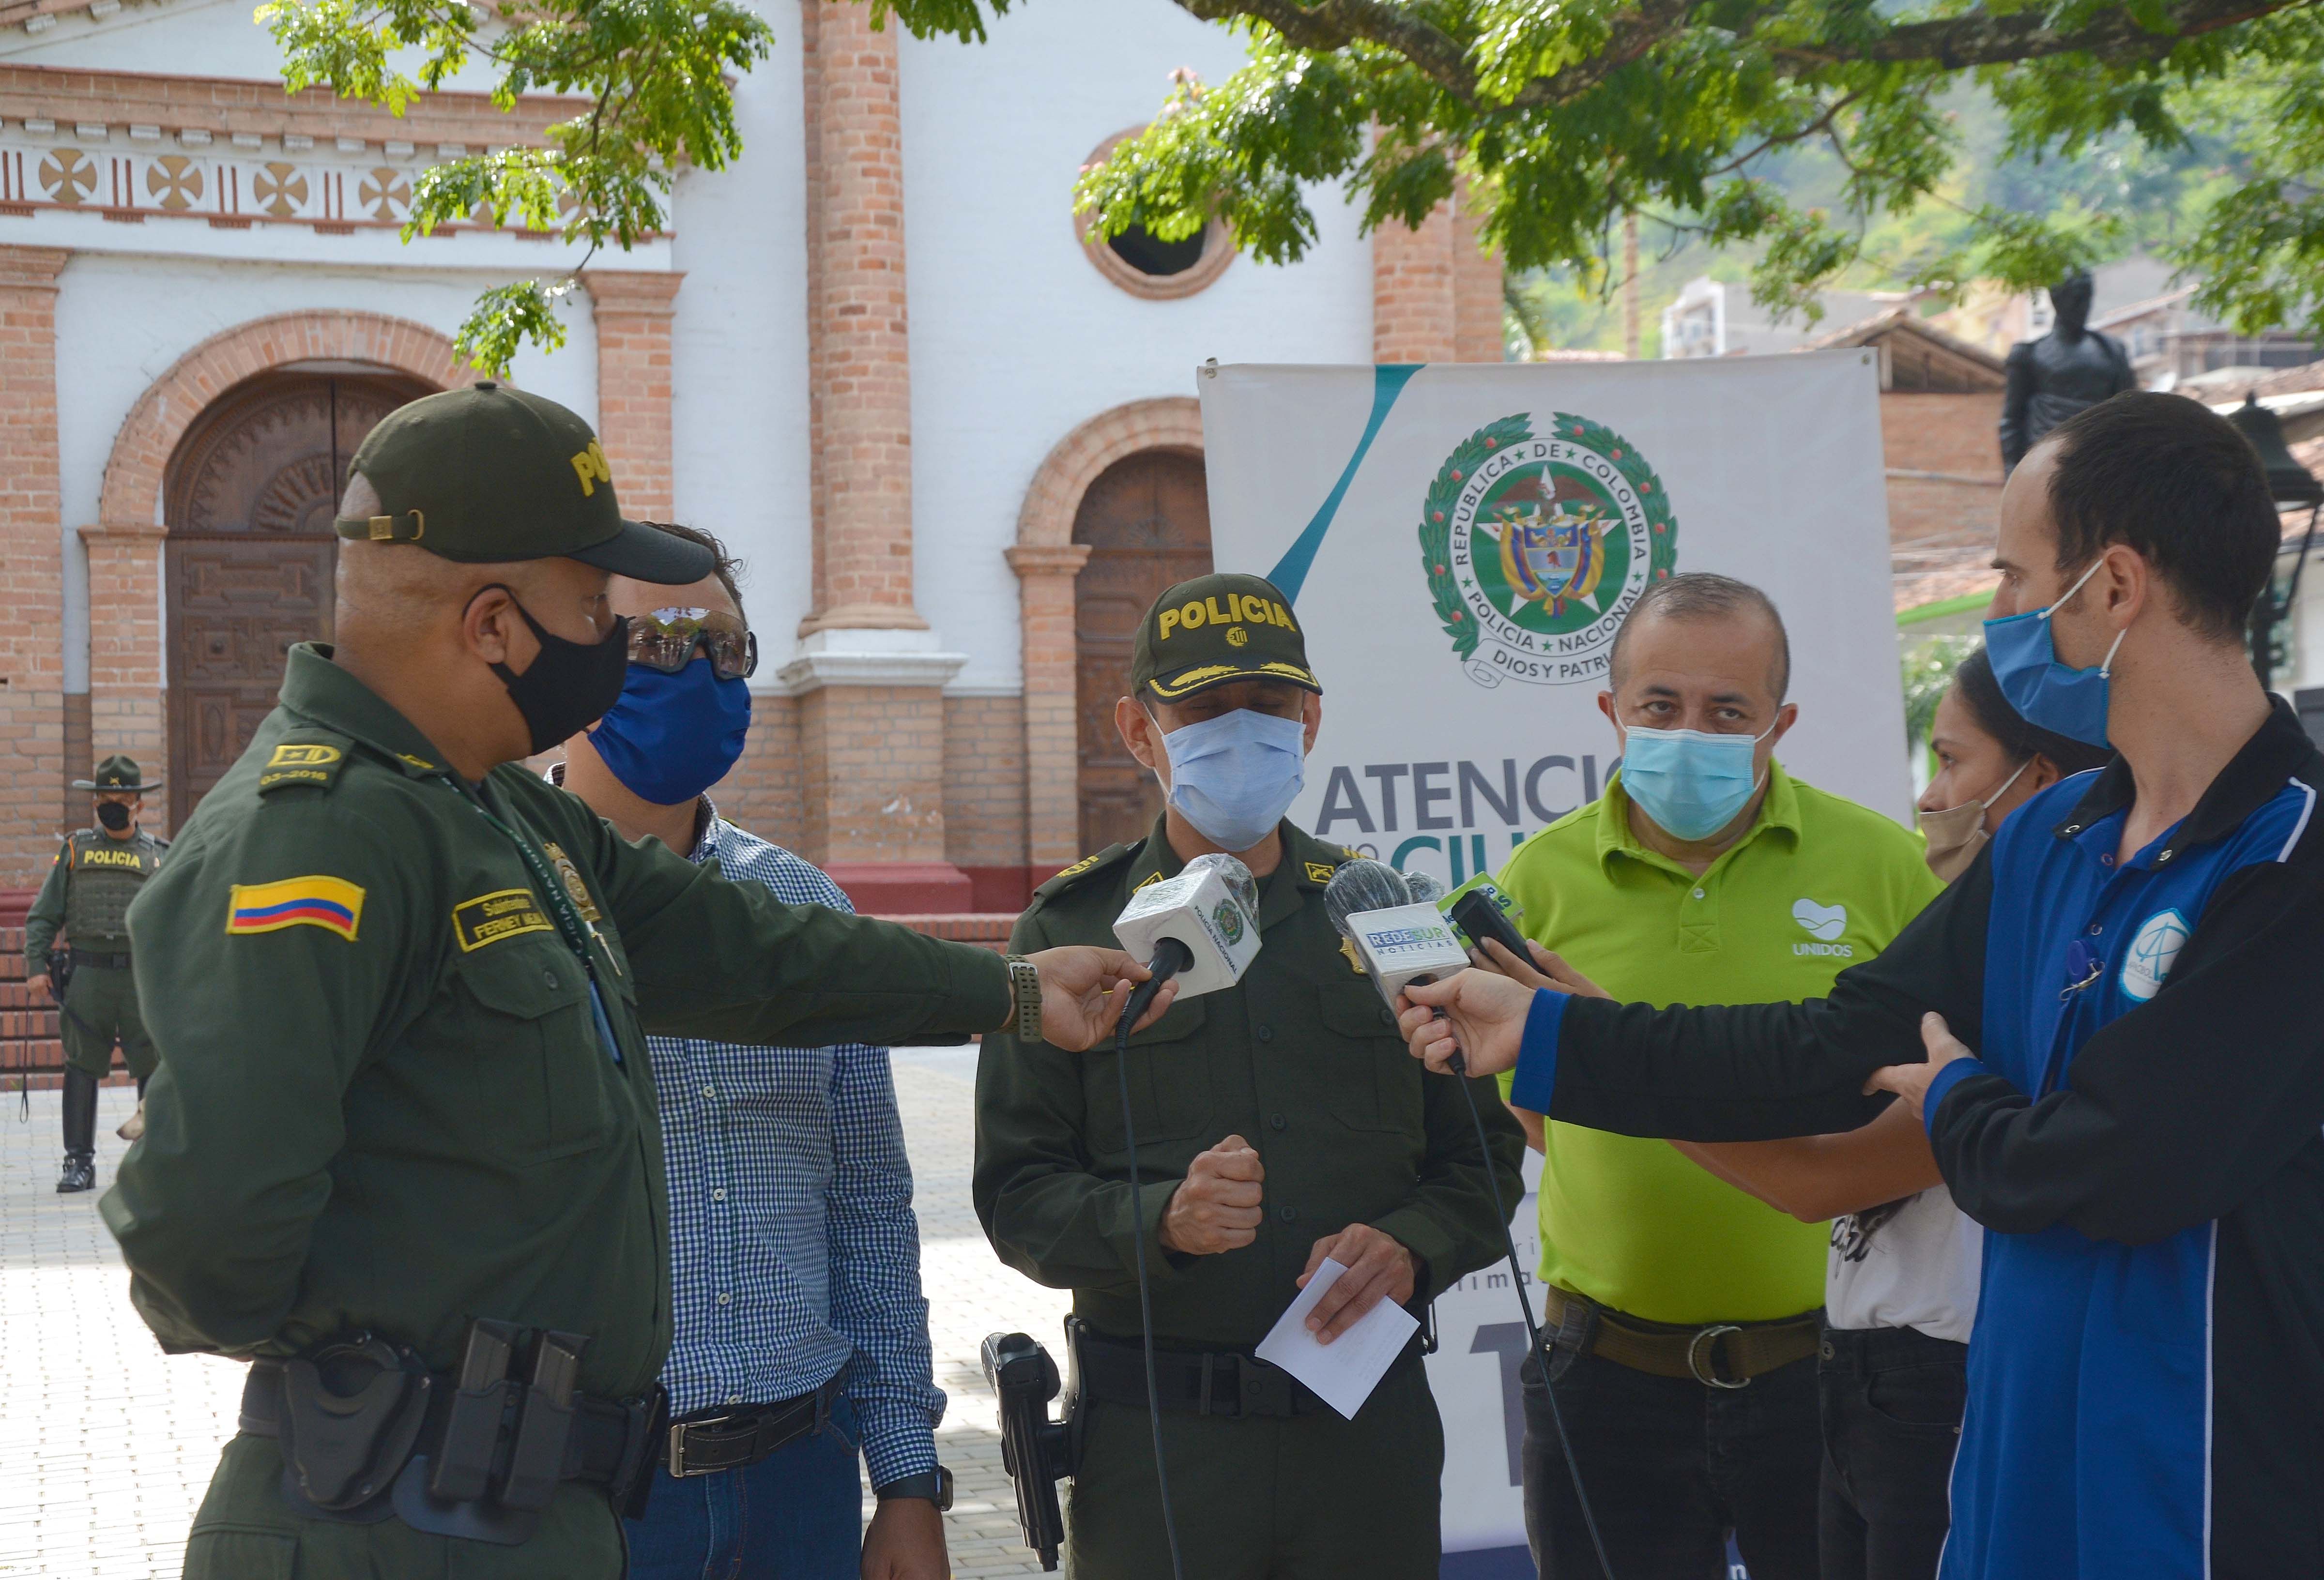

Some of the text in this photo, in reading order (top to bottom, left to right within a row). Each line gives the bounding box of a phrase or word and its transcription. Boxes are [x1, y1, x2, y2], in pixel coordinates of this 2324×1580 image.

[1534, 443, 1560, 458] DE
[1583, 455, 1647, 561] COLOMBIA
[1159, 593, 1296, 640] POLICIA
[1559, 585, 1641, 652] NACIONAL
[1493, 650, 1610, 678] DIOS Y PATRI
[84, 850, 141, 868] POLICIA
[1212, 934, 1238, 974] NACIONAL
[1376, 940, 1453, 955] NOTICIAS
[1793, 942, 1853, 957] UNIDOS
